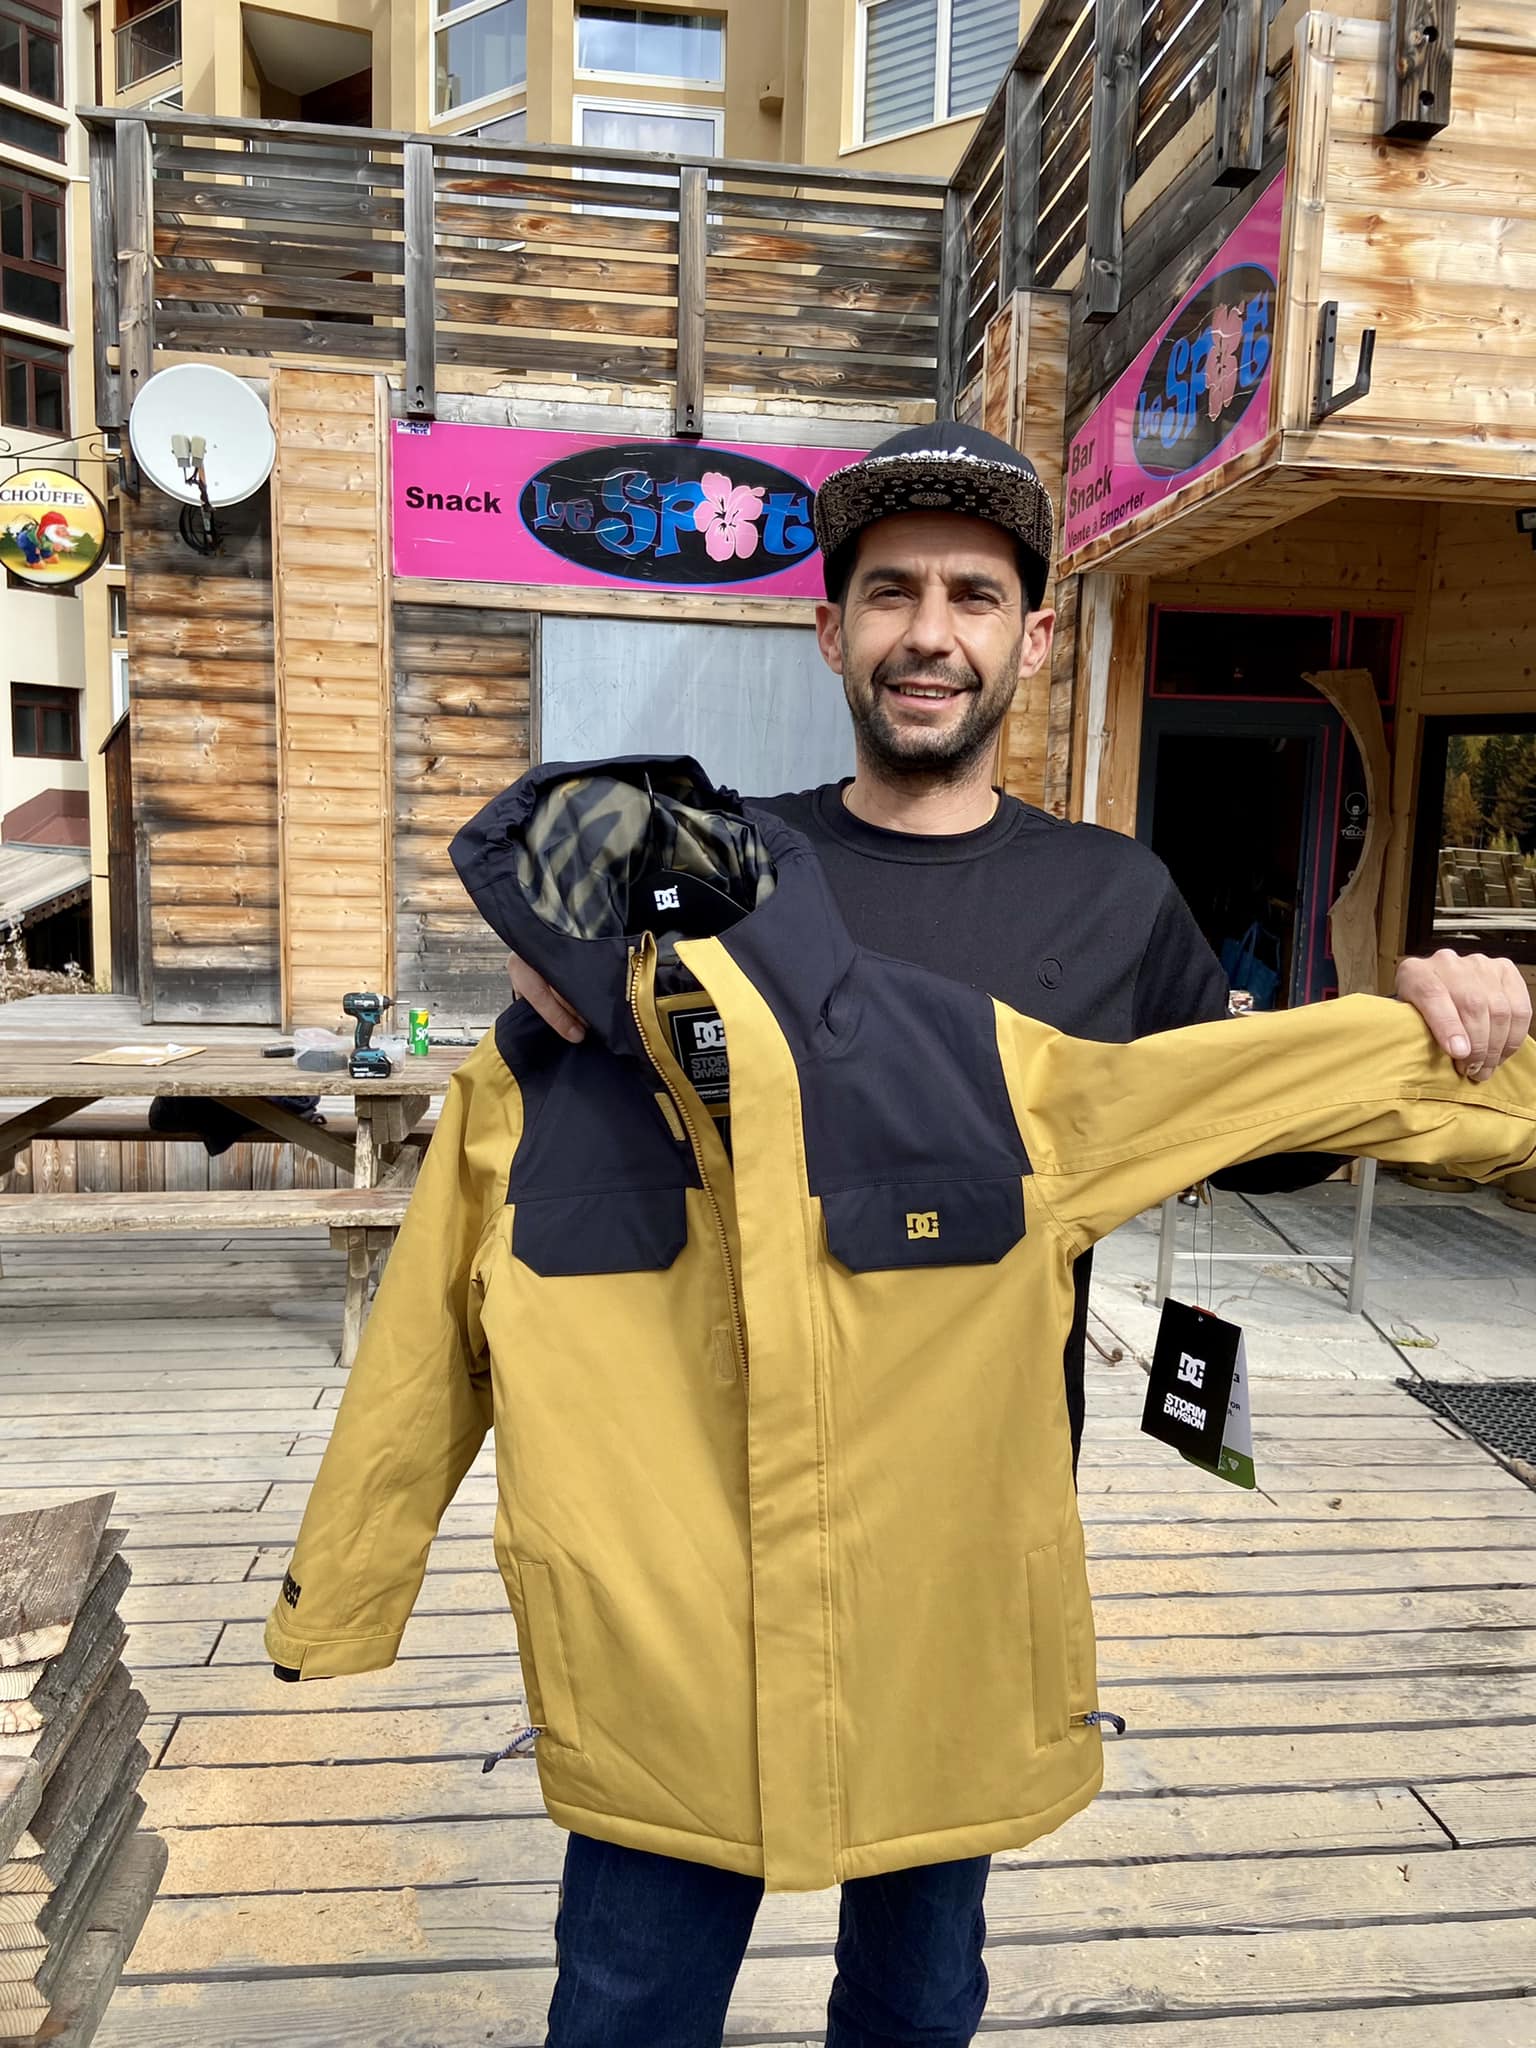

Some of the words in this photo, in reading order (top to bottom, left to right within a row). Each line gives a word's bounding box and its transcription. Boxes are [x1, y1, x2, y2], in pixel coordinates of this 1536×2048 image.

[1071, 438, 1096, 477] Bar
[0, 489, 85, 504] CHOUFFE
[34, 481, 47, 489] LA
[1069, 464, 1112, 519] Snack
[405, 486, 502, 514] Snack
[1067, 521, 1091, 549] Vente
[1092, 515, 1098, 534] à
[1099, 491, 1145, 530] Emporter
[690, 1055, 728, 1070] STOR
[692, 1066, 728, 1079] DIVISI
[1163, 1403, 1206, 1432] DIVISION
[1164, 1392, 1207, 1421] STORM
